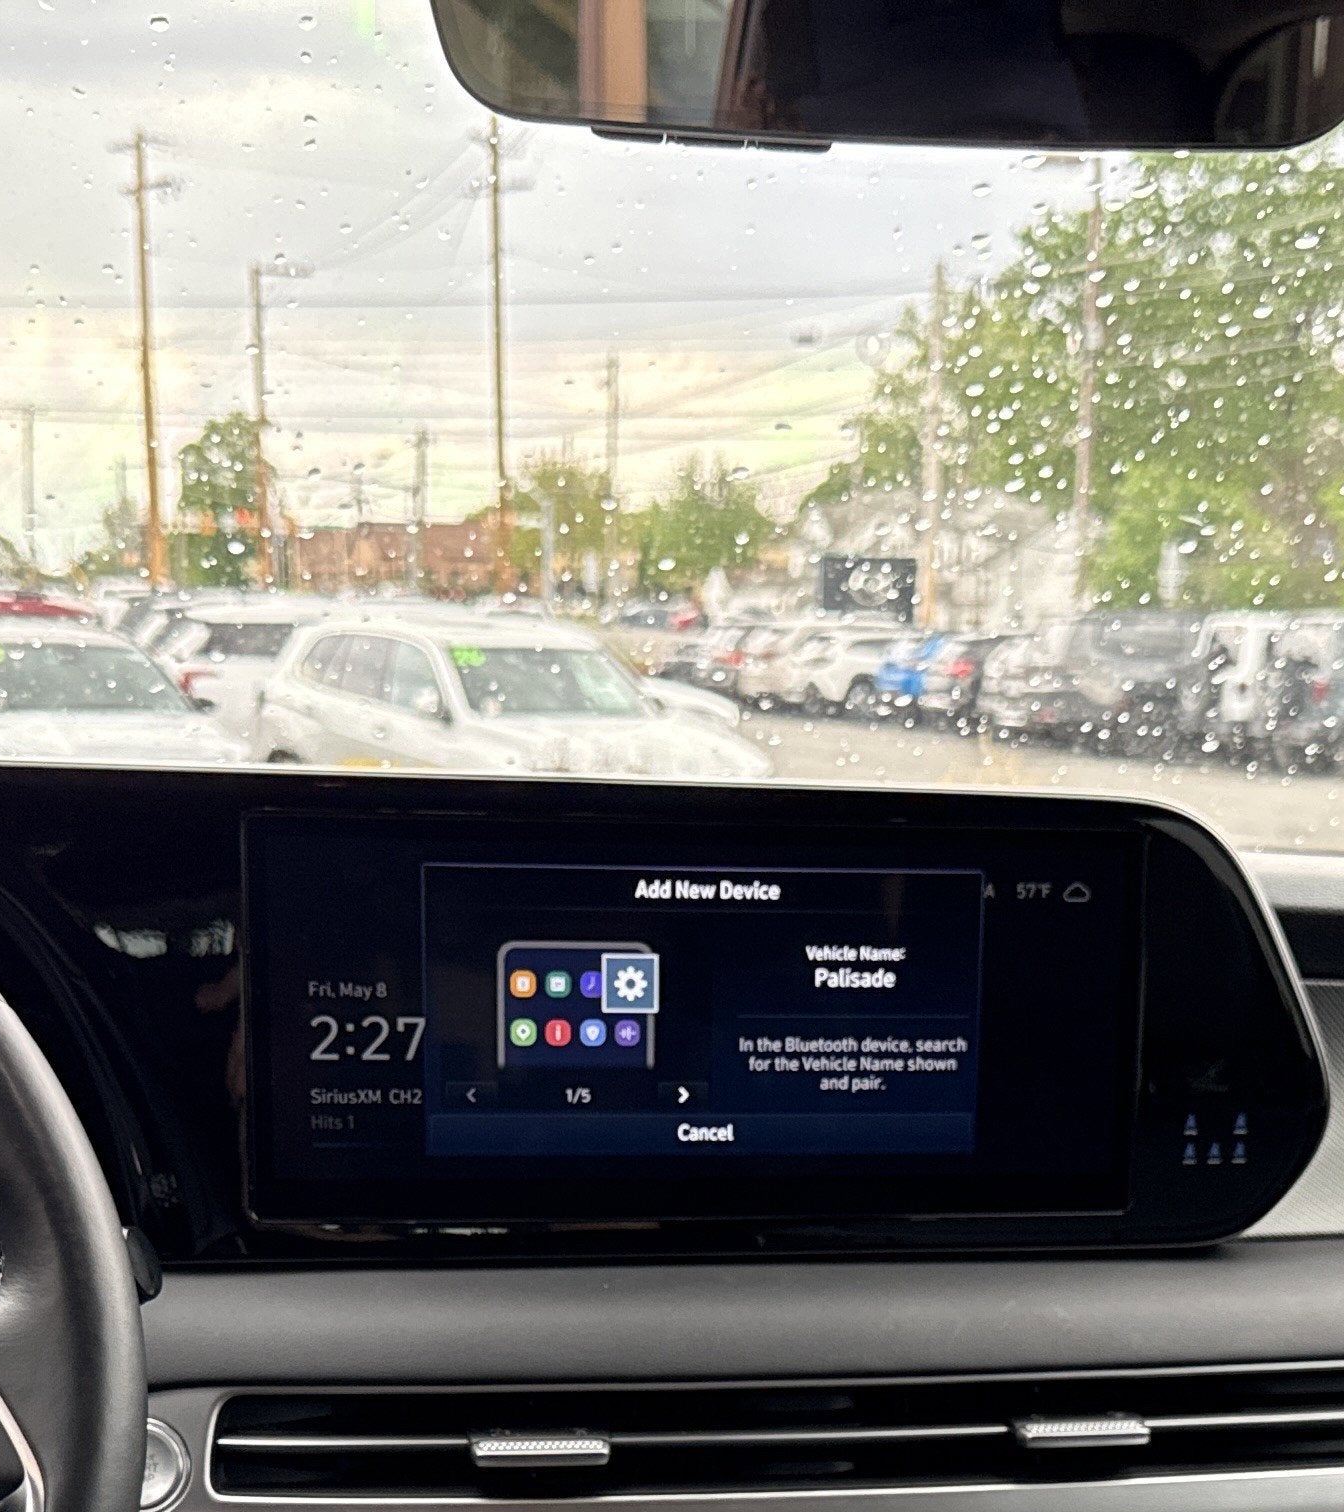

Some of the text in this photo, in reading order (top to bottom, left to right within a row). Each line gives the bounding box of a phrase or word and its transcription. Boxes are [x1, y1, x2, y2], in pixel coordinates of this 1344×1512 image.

[635, 879, 781, 900] Add New Device
[806, 945, 905, 961] Vehicle Name:
[814, 967, 896, 988] Palisade
[339, 982, 373, 1001] May
[375, 982, 388, 998] 8
[310, 1015, 426, 1061] 2:27
[739, 1037, 968, 1054] In the Bluetooth device, search
[748, 1056, 958, 1072] for the Vehicle Name shown
[820, 1075, 887, 1093] and pair.
[310, 1088, 382, 1104] SiriusXM
[565, 1088, 592, 1104] 1/5
[310, 1115, 355, 1129] Hits 1
[677, 1122, 735, 1142] Cancel
